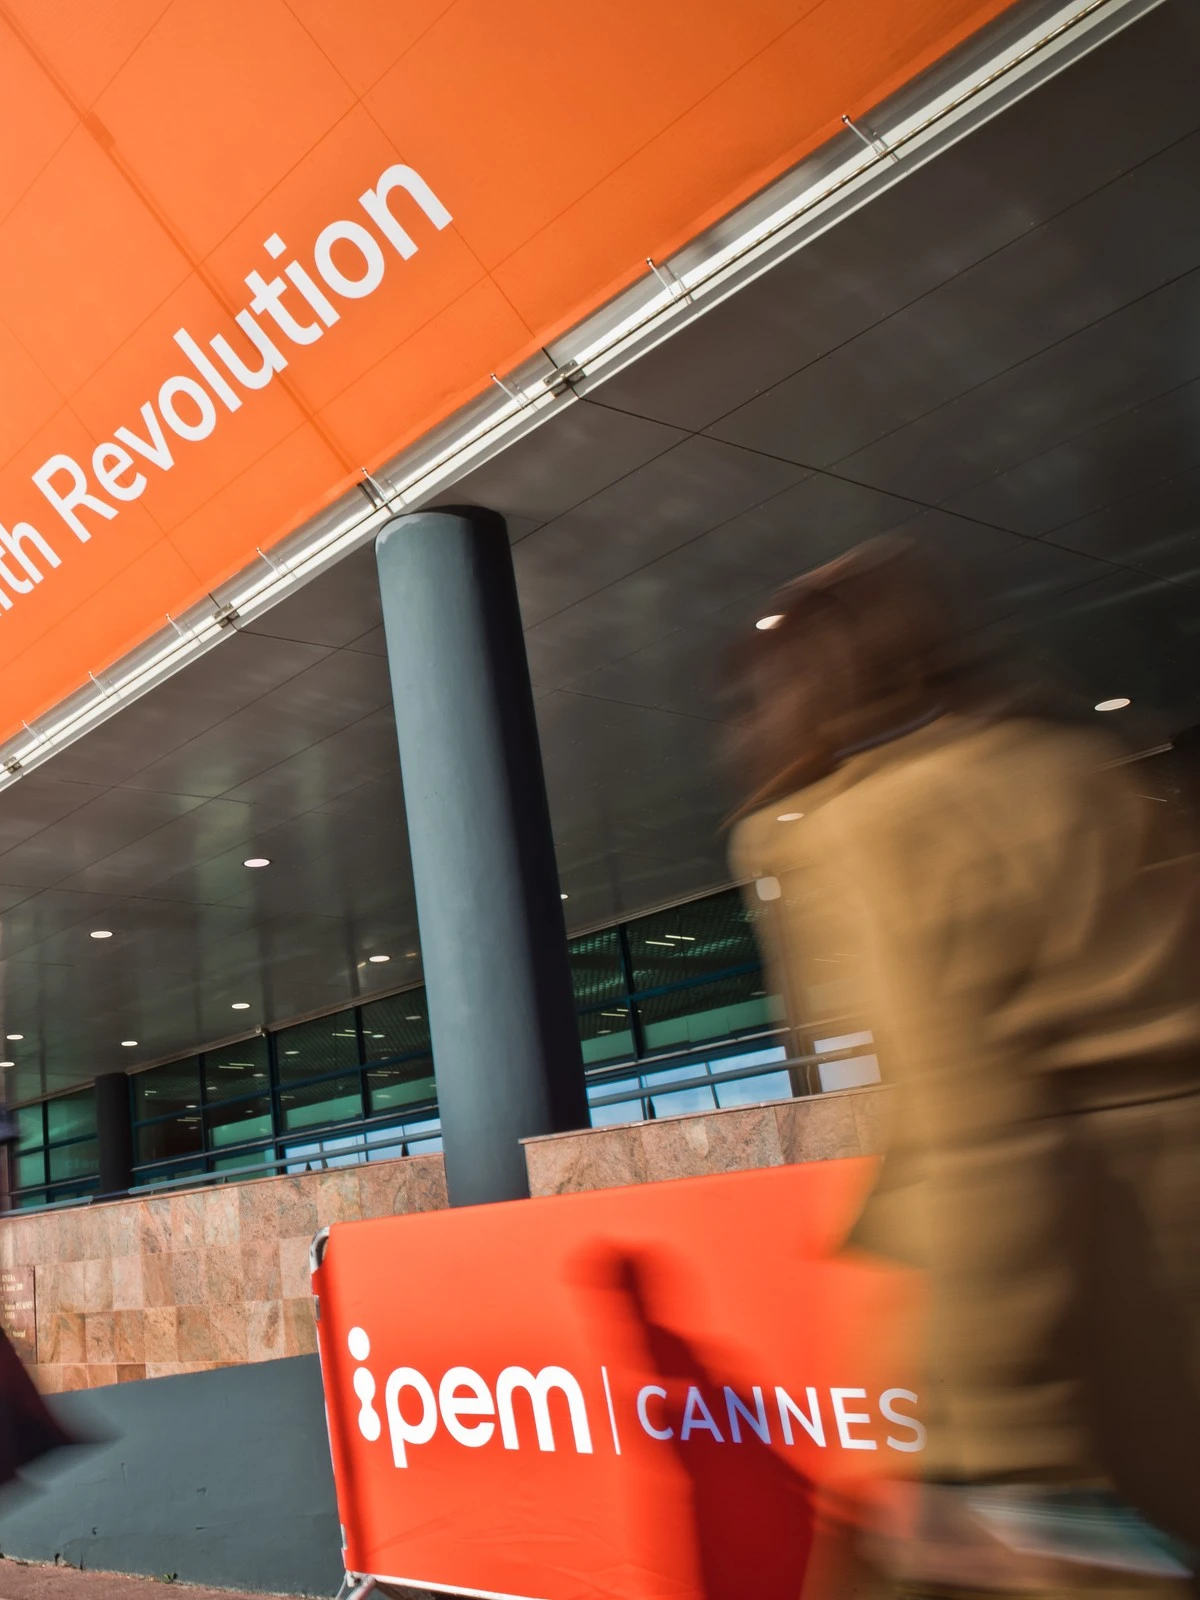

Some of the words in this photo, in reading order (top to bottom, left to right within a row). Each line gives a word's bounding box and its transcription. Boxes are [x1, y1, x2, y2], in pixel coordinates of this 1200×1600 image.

[32, 164, 453, 543] Revolution
[348, 1327, 593, 1469] ipem
[637, 1384, 928, 1453] CANNES
